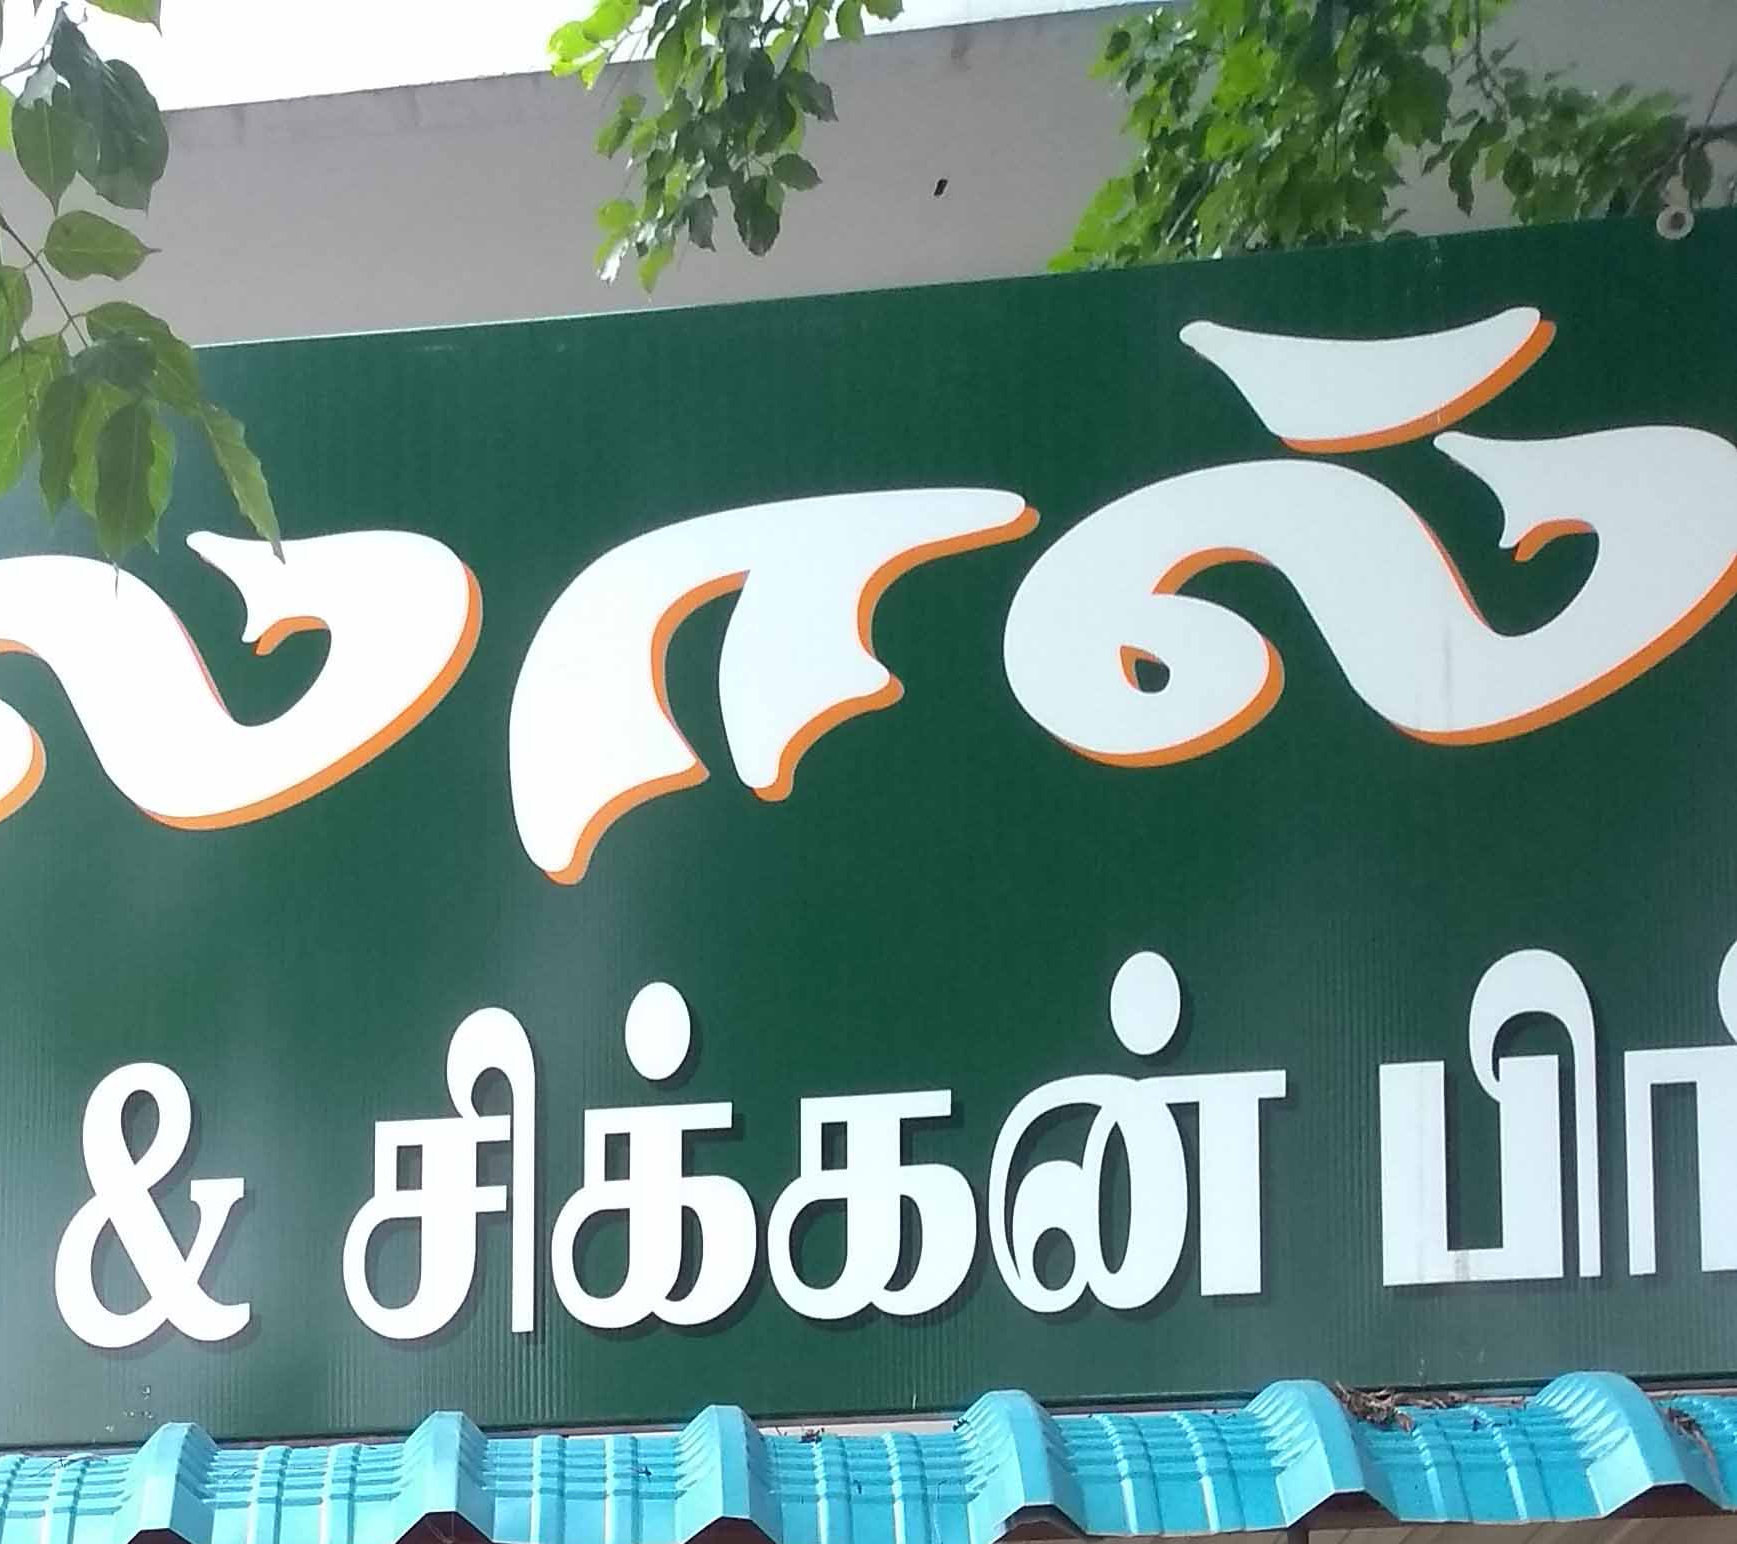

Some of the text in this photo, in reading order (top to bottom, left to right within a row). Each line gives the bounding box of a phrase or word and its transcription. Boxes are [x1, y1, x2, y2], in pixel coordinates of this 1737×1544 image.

[53, 1061, 252, 1350] &
[342, 950, 1287, 1337] சிக்கன்
[1379, 938, 1737, 1288] பிர
